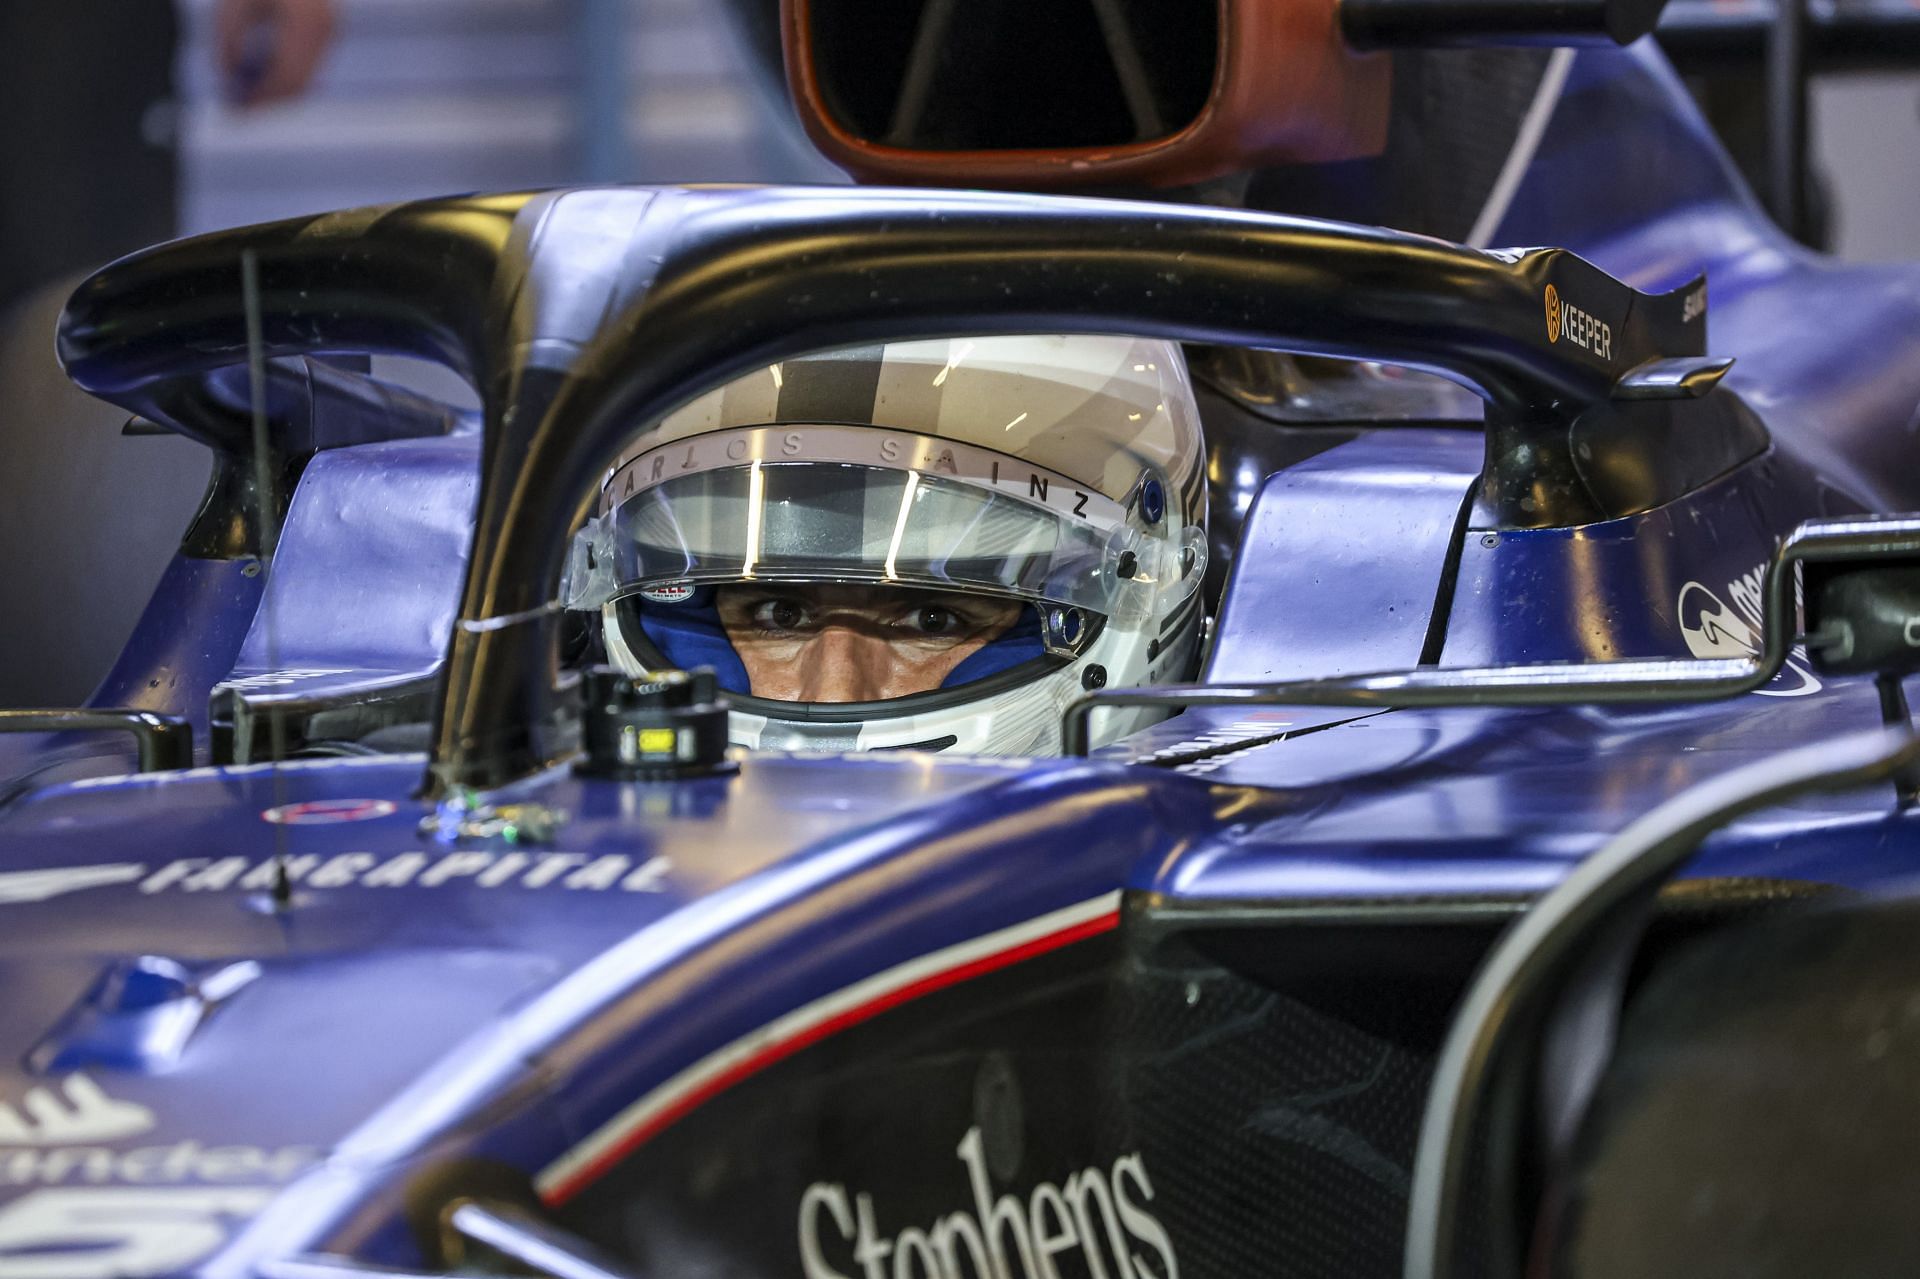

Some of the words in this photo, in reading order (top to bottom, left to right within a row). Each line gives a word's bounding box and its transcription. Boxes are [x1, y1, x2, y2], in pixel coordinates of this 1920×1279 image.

[1561, 300, 1611, 361] KEEPER
[606, 433, 803, 513] CARLOS
[880, 438, 1089, 519] SAINZ
